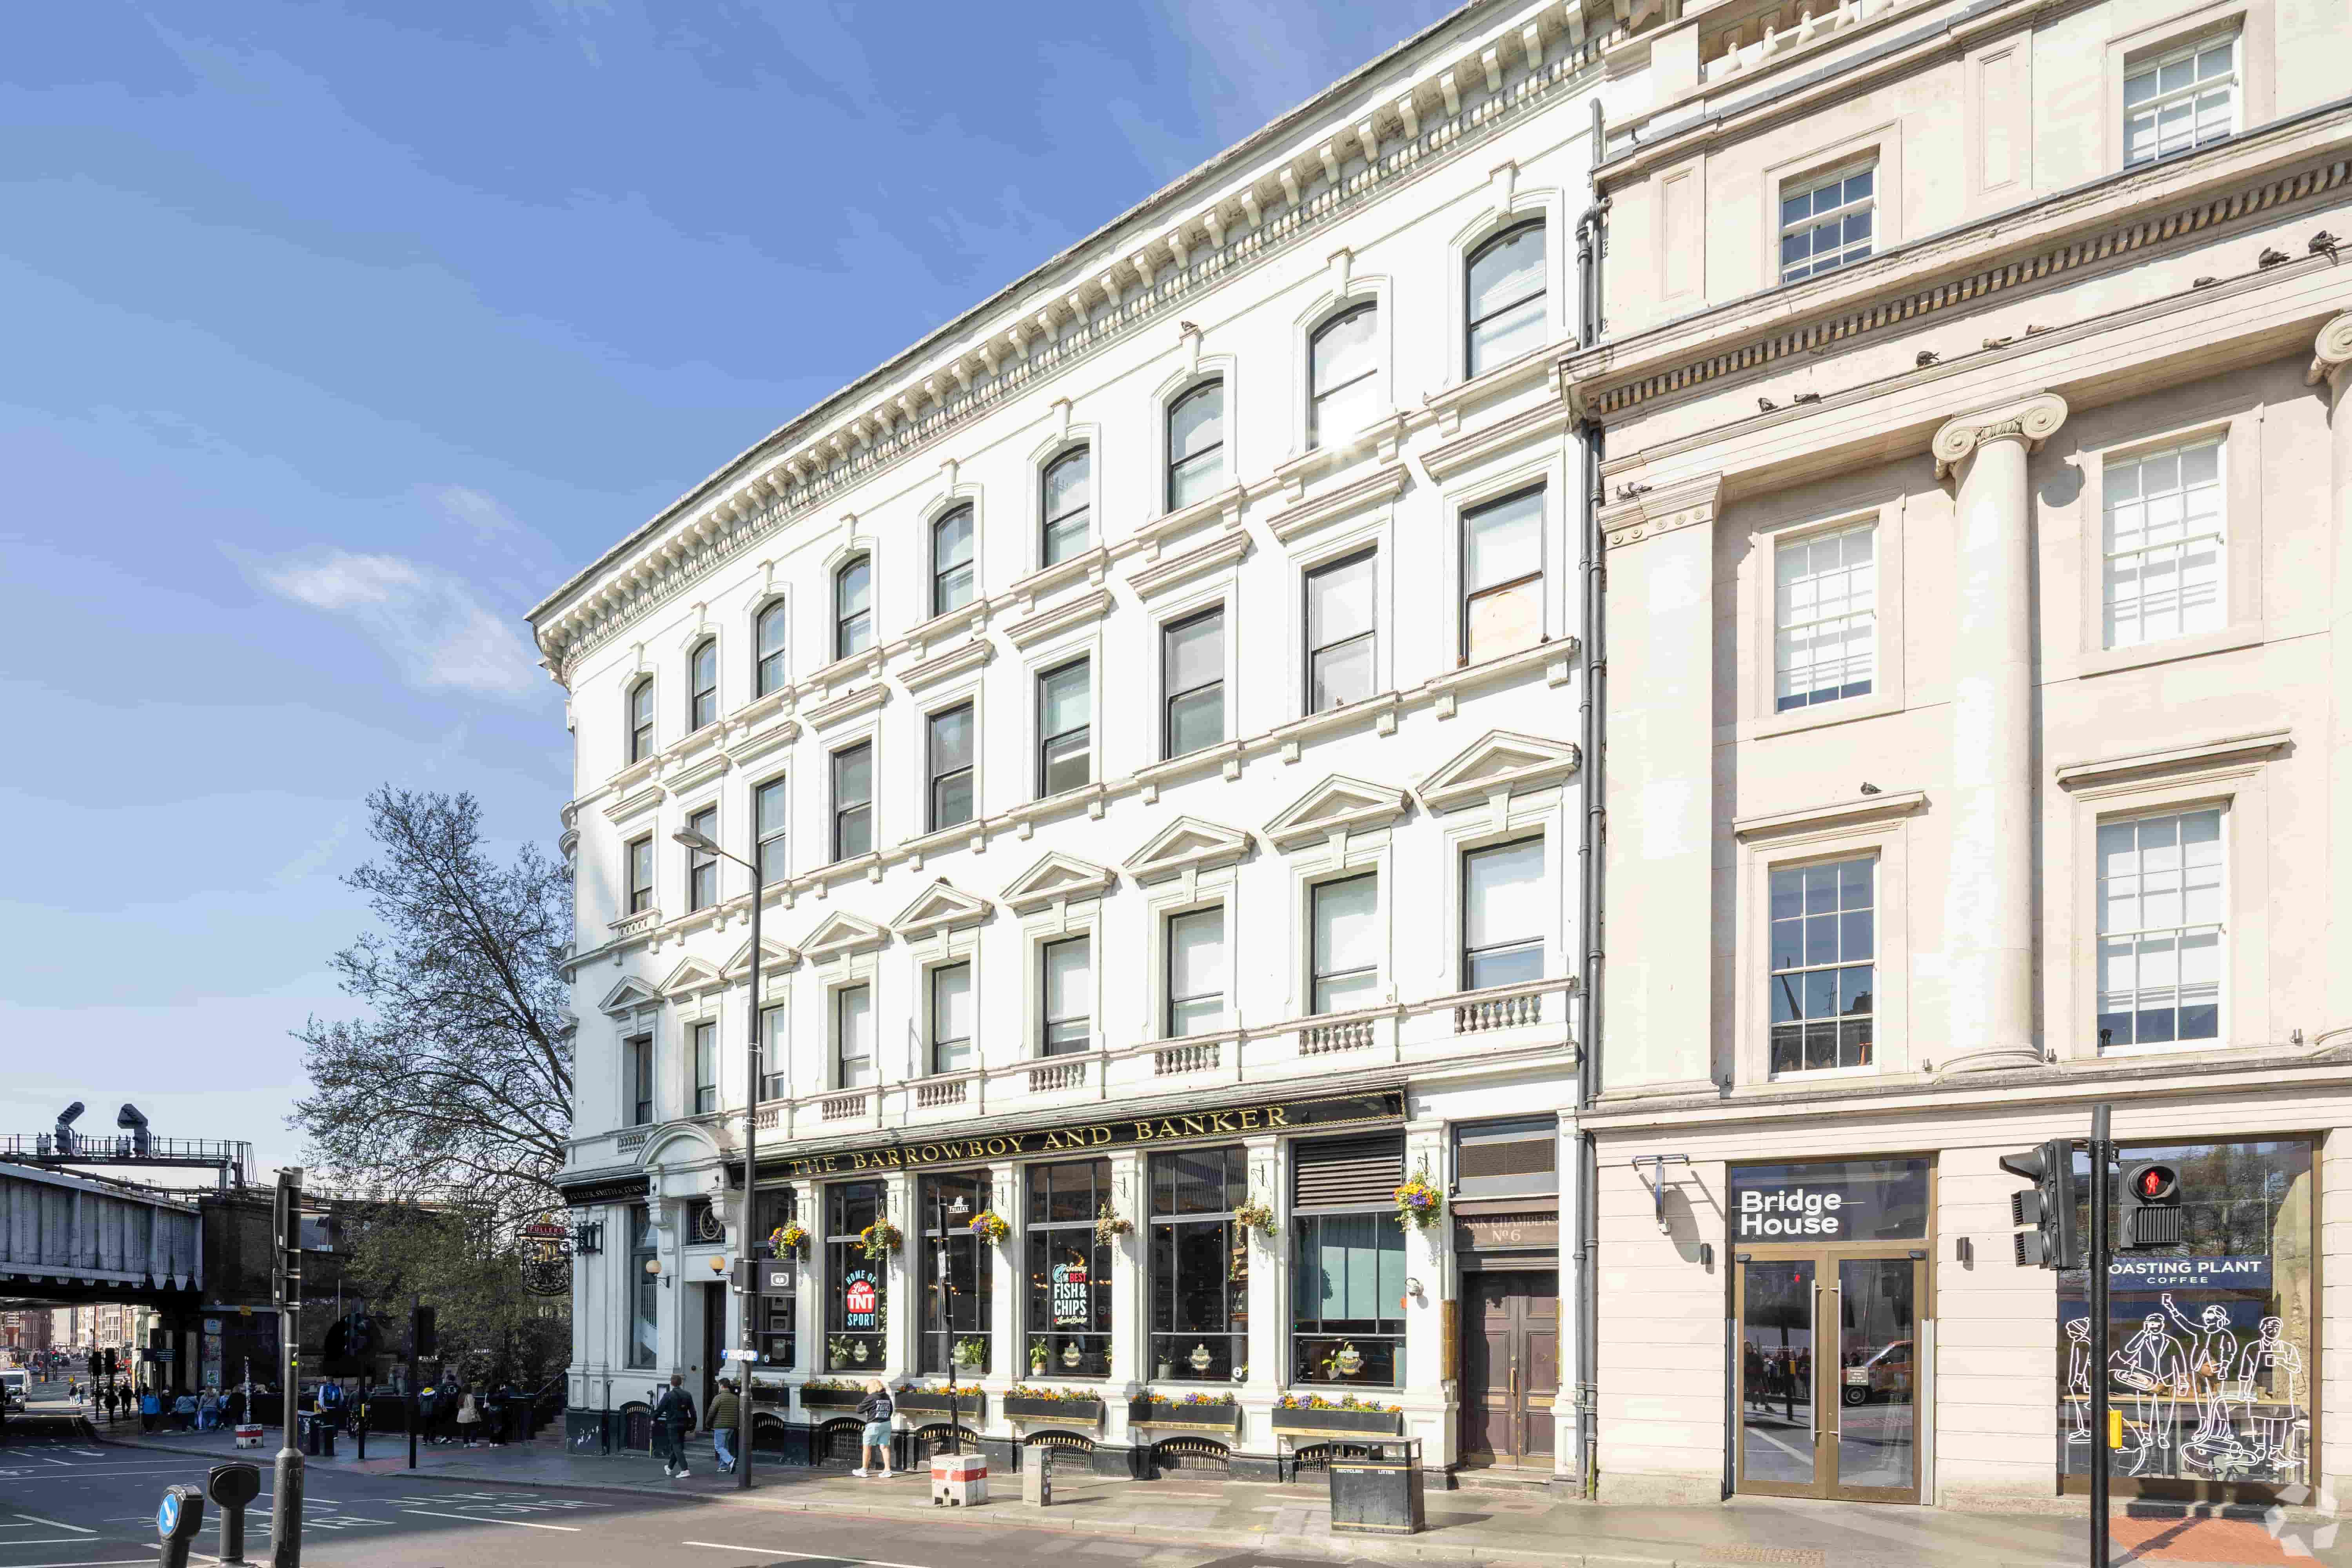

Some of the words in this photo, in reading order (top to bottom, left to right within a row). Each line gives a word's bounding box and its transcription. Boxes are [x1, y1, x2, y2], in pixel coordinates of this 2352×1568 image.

[789, 1156, 838, 1175] THE
[853, 1134, 1025, 1169] BARROWBOY
[1042, 1127, 1112, 1149] AND
[1136, 1107, 1291, 1140] BANKER
[1741, 1189, 1841, 1216] Bridge
[1457, 1216, 1488, 1230] BANK
[1491, 1214, 1559, 1228] CHAMBERS
[1741, 1214, 1839, 1235] House
[2108, 1262, 2192, 1274] OASTING
[2198, 1261, 2262, 1273] PLANT
[846, 1270, 866, 1285] HOME
[867, 1273, 877, 1284] OF
[1070, 1273, 1086, 1282] BEST
[851, 1282, 869, 1294] Live
[847, 1294, 875, 1309] TNT
[1054, 1300, 1087, 1316] CHIPS
[848, 1313, 875, 1326] SPORT
